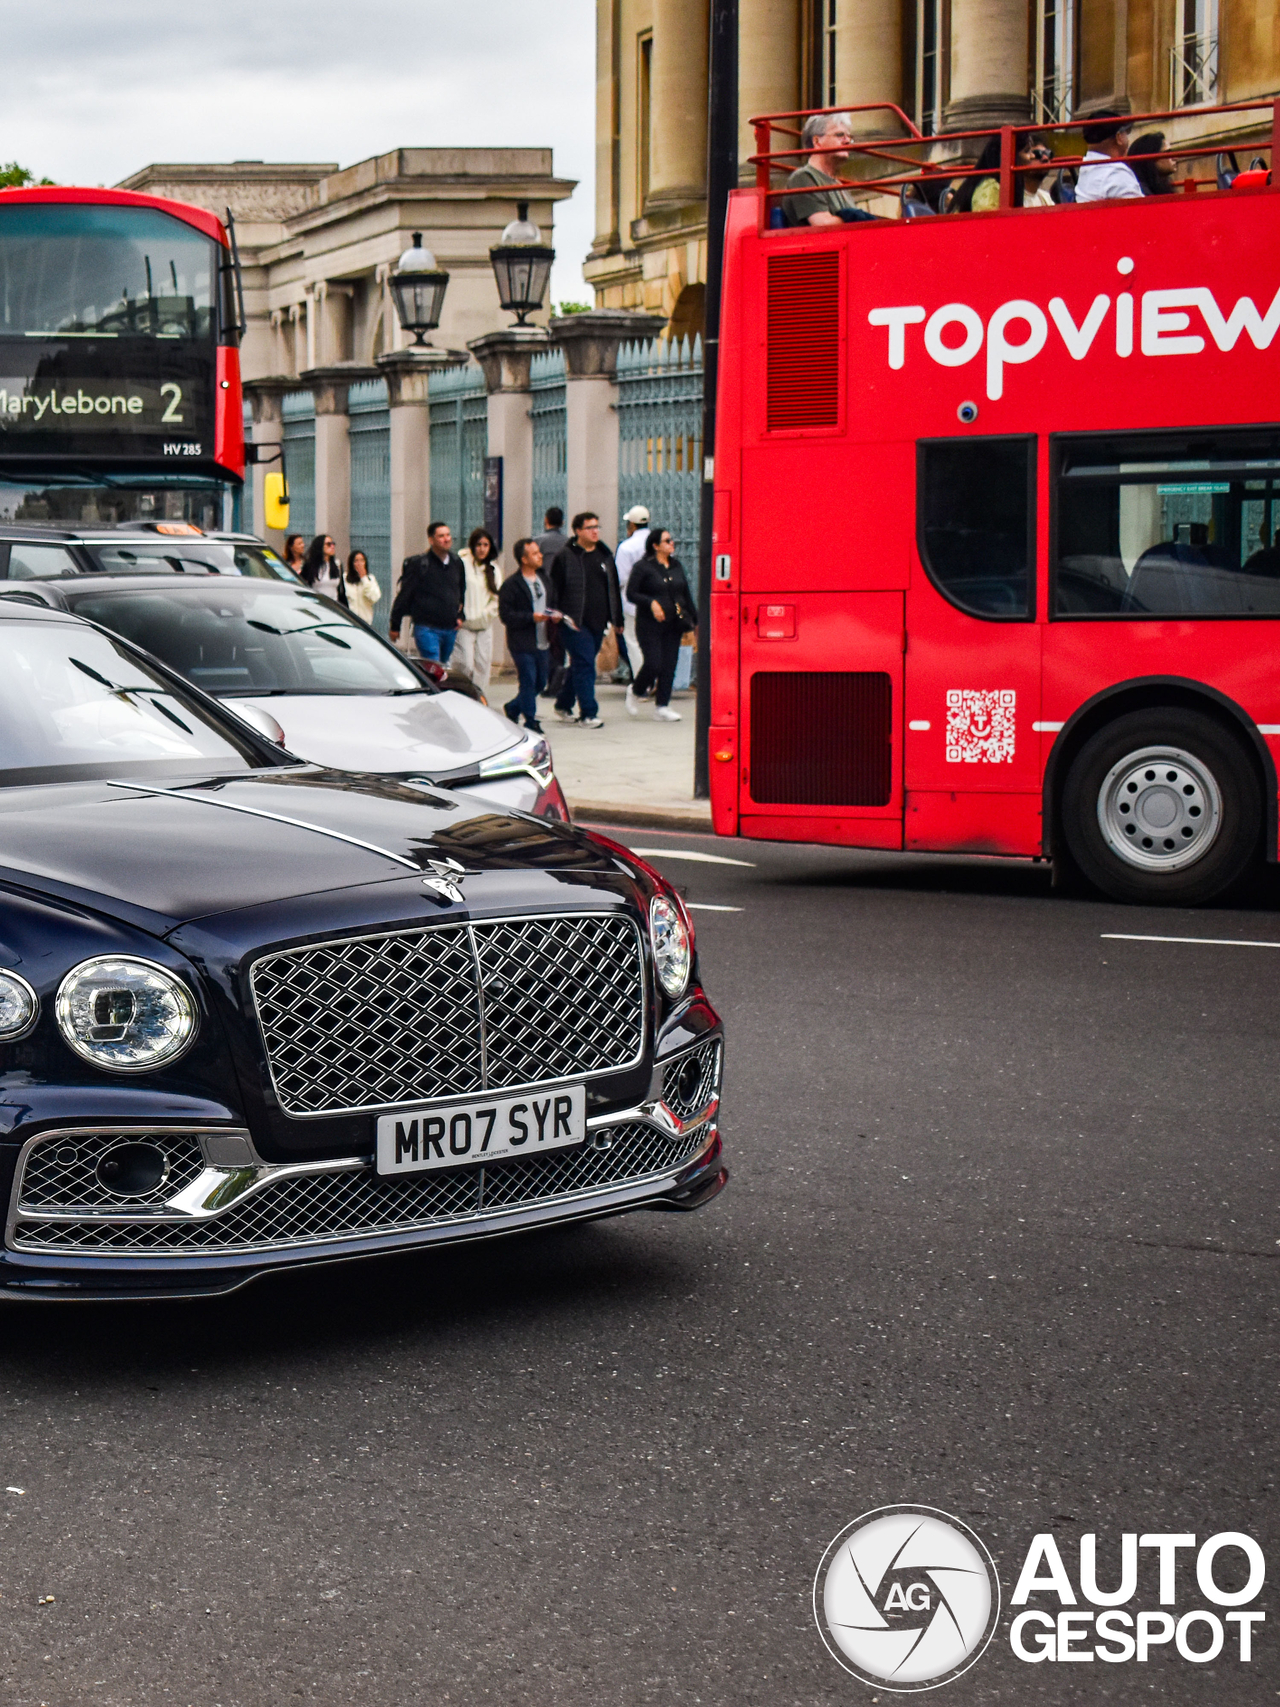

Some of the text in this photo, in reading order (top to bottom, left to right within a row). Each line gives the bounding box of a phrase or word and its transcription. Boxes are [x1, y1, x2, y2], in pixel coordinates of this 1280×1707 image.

[160, 382, 184, 423] 2
[163, 443, 202, 456] HV 285
[394, 1095, 572, 1165] MR07 SYR
